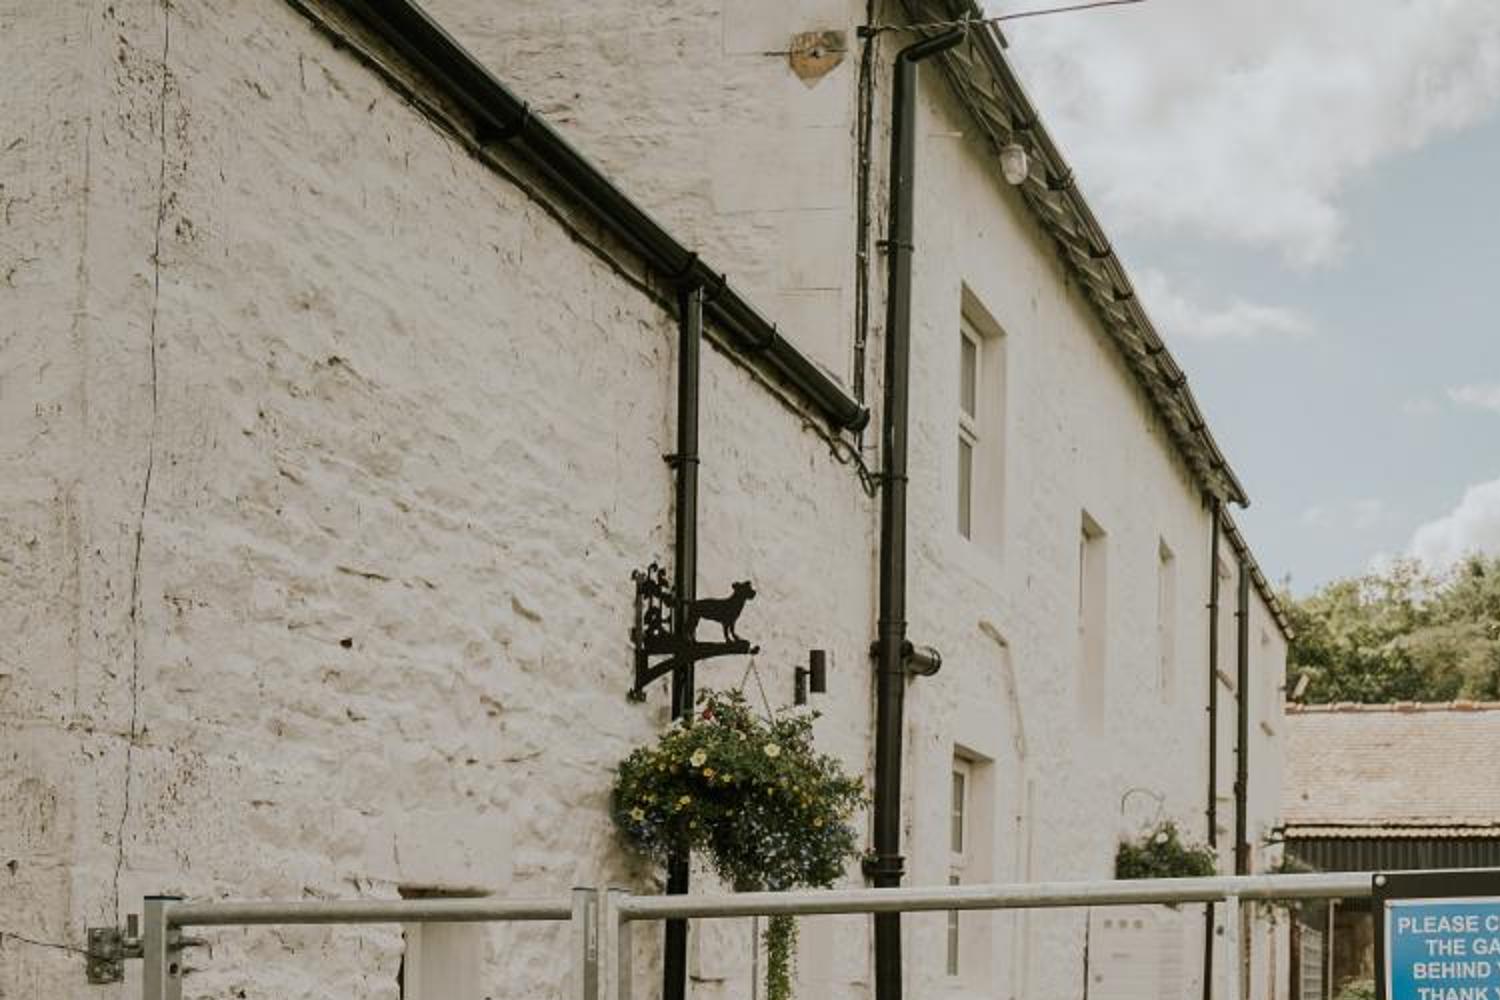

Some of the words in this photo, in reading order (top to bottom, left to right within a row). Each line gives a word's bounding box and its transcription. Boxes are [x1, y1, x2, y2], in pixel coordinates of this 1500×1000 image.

[1398, 915, 1479, 935] PLEASE
[1426, 939, 1465, 956] THE
[1413, 961, 1488, 979] BEHIND
